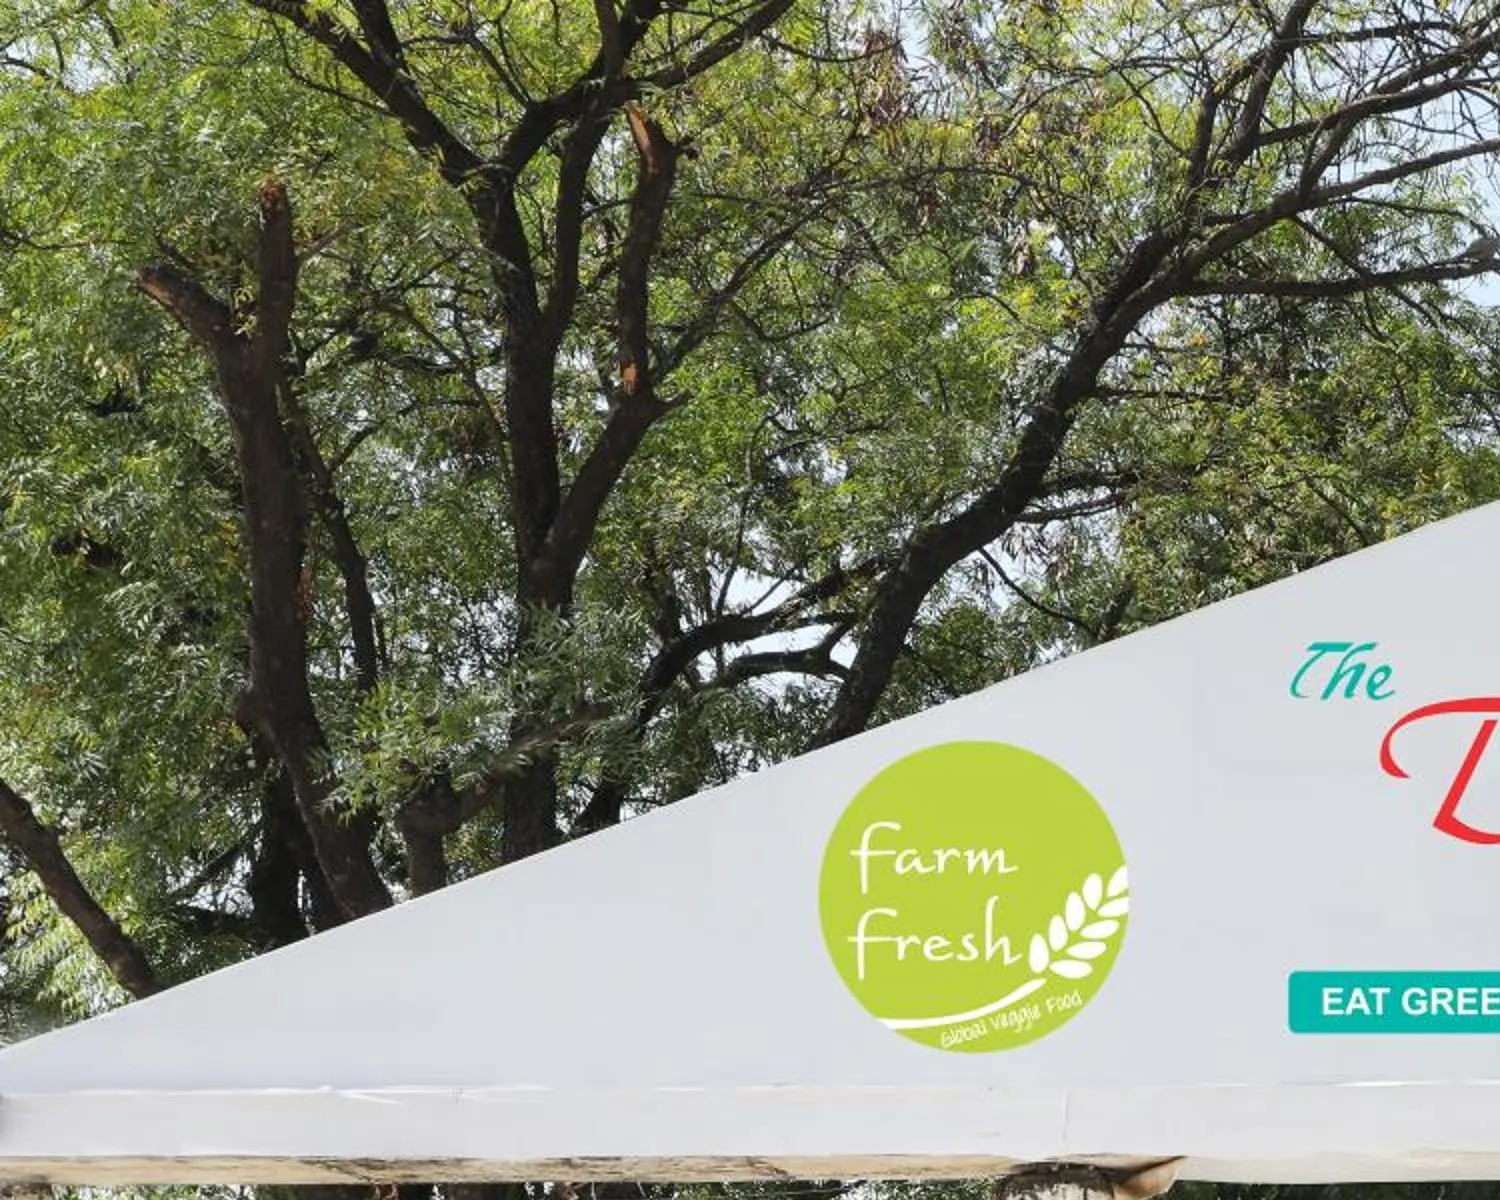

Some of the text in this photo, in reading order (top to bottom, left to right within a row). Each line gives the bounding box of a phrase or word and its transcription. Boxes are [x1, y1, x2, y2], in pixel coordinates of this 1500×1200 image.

[1290, 640, 1395, 700] The
[850, 821, 1018, 894] farm
[848, 896, 1022, 981] fresh
[1045, 989, 1083, 1014] Food
[1322, 987, 1390, 1016] EAT
